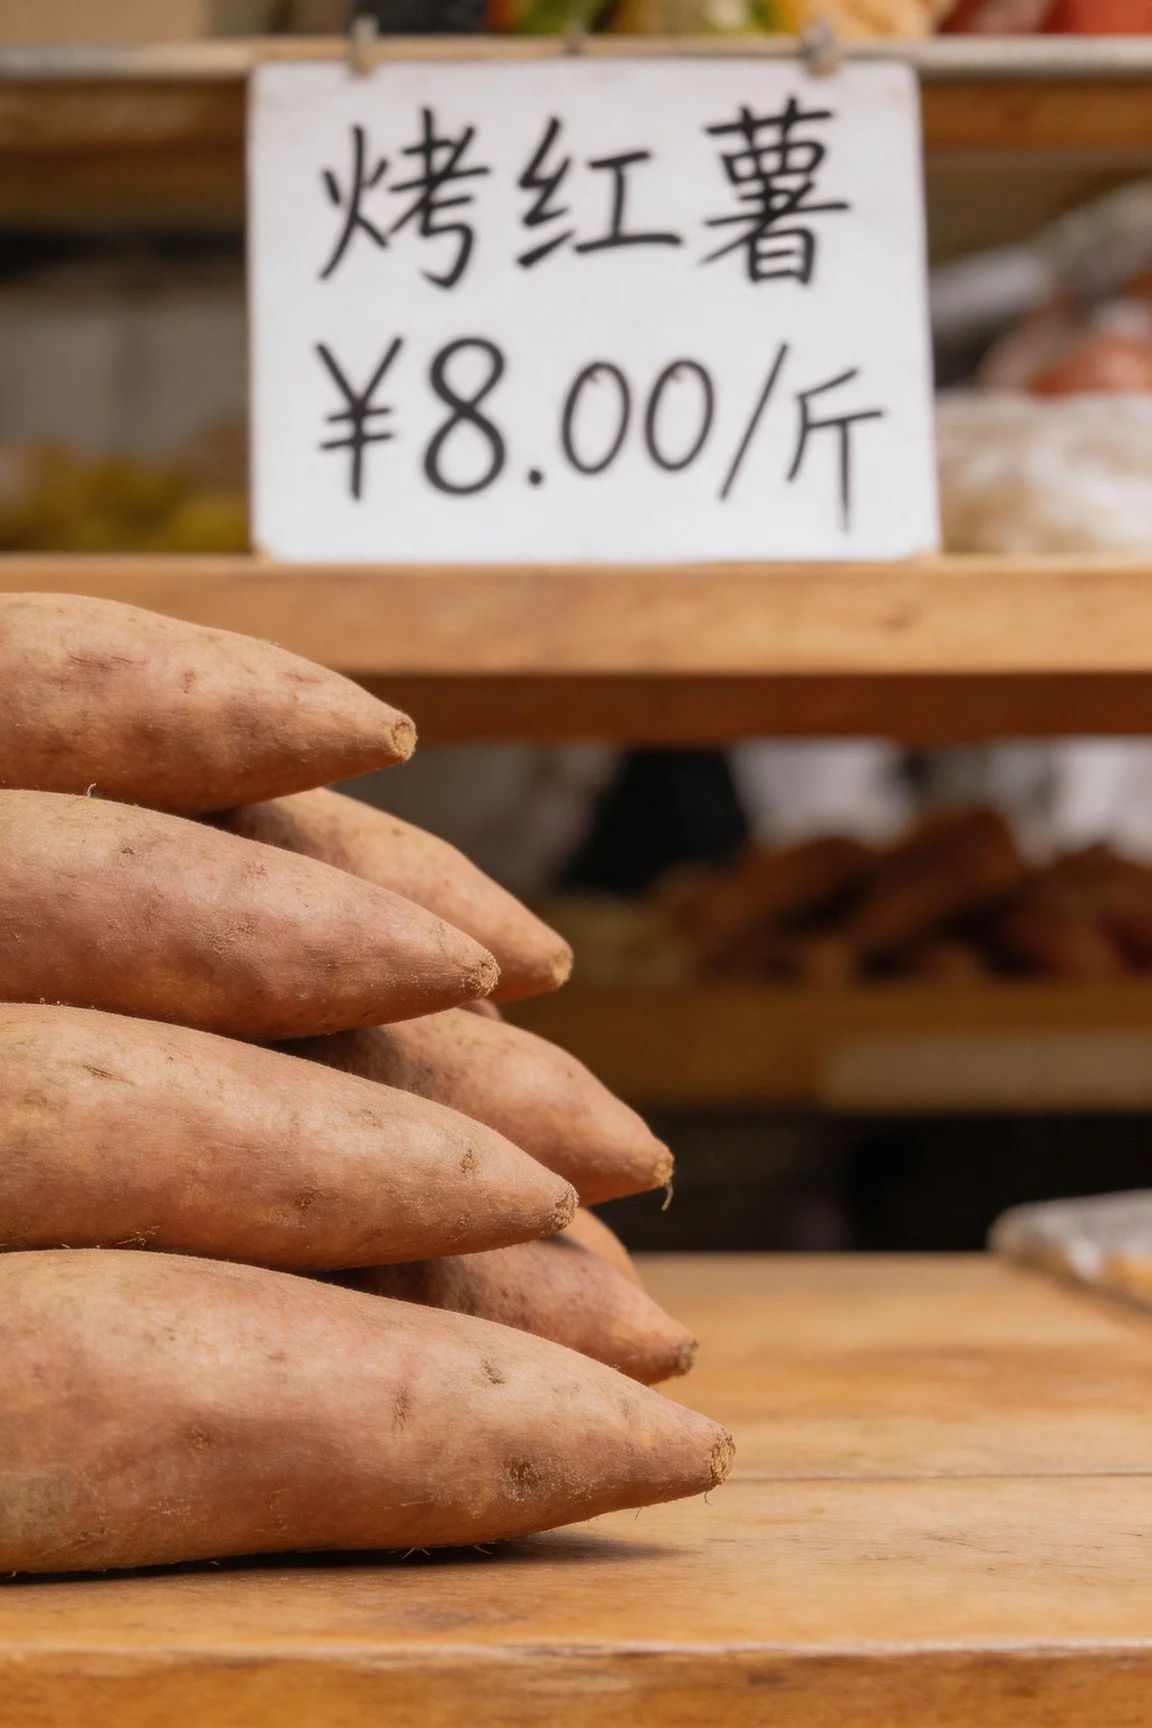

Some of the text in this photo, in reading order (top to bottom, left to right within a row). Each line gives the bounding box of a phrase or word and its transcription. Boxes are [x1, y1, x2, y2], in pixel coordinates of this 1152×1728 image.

[321, 96, 850, 289] 烤红薯
[316, 337, 884, 530] ¥8.00/斤
